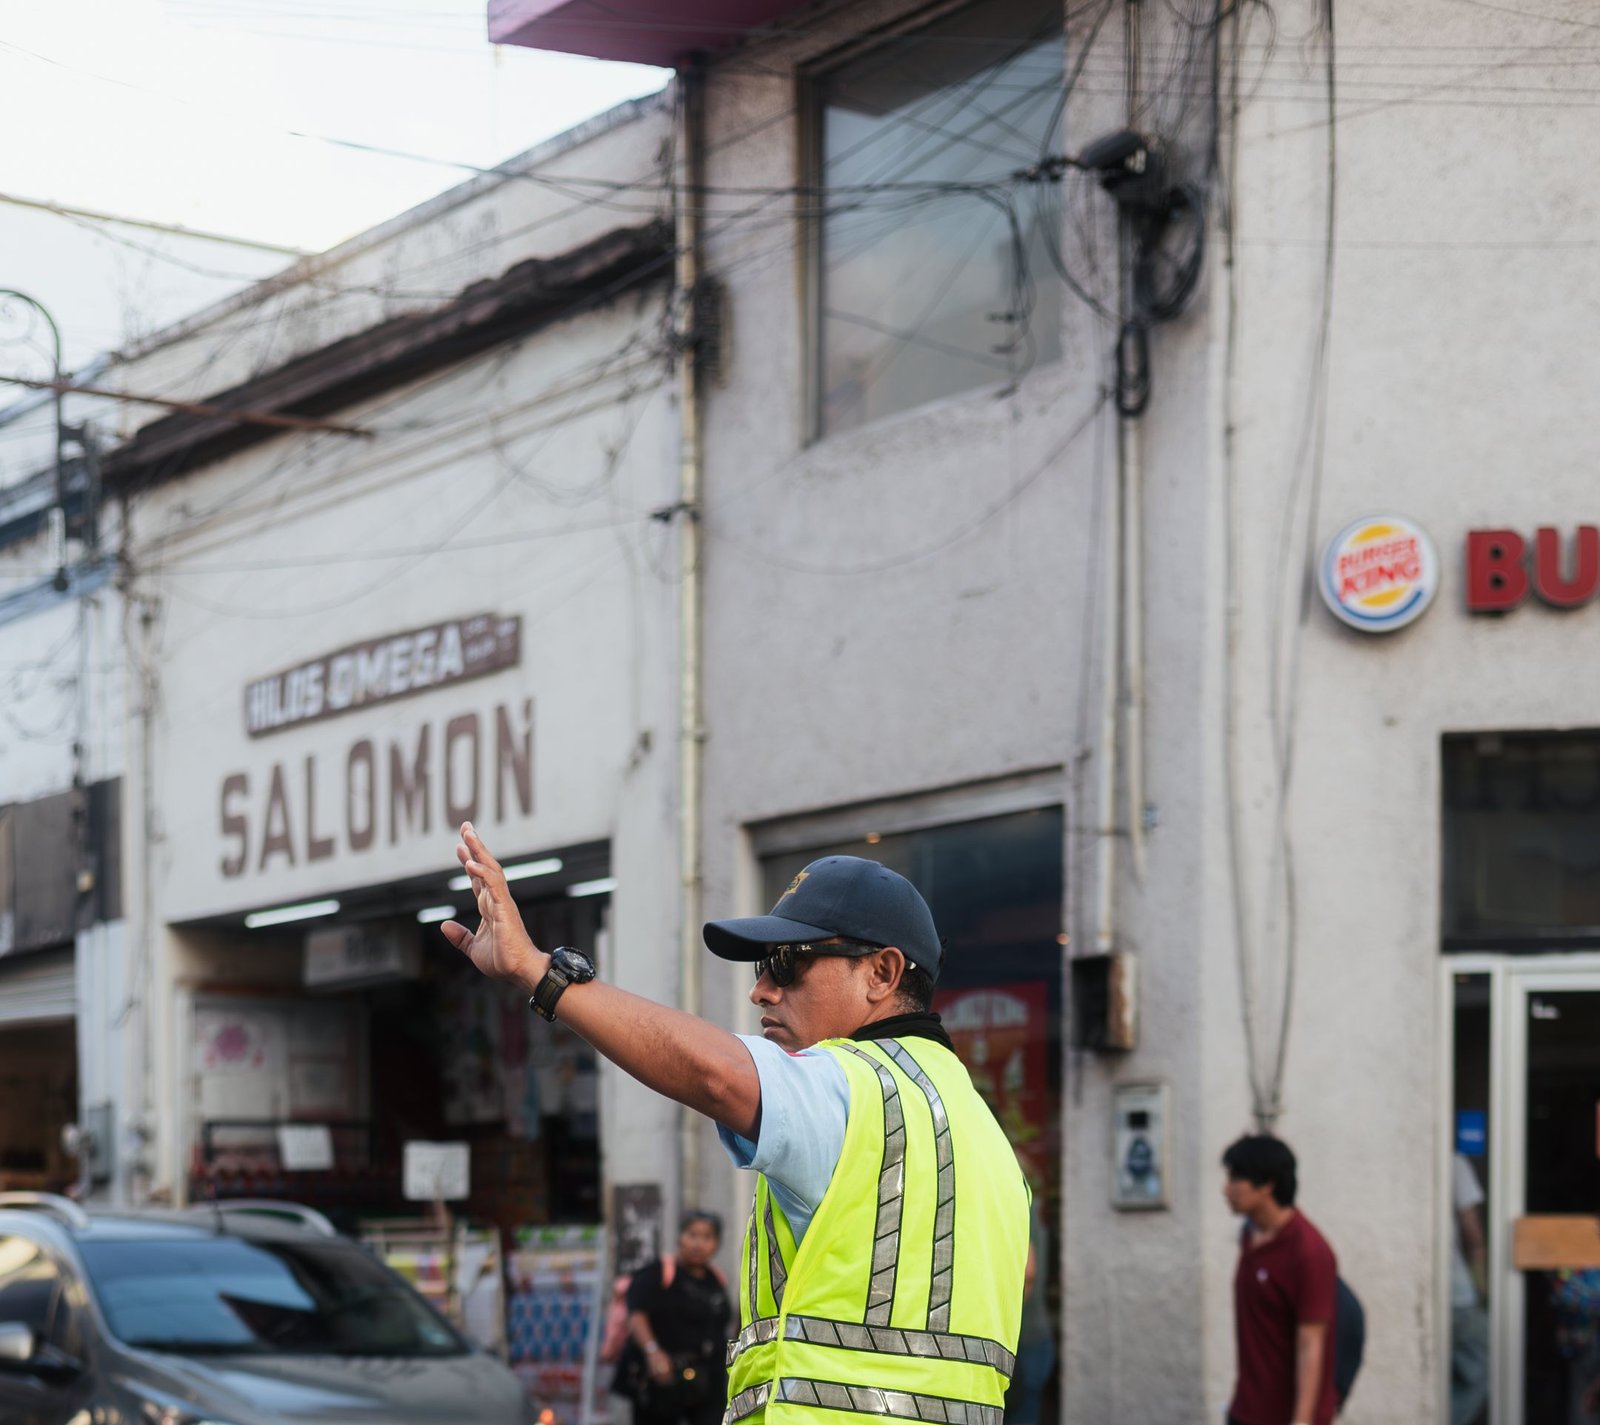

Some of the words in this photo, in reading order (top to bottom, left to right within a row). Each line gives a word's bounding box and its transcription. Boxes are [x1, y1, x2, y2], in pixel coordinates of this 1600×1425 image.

[1339, 558, 1421, 603] KING
[1340, 538, 1418, 572] BURGER
[1467, 526, 1599, 610] BU
[248, 662, 326, 733] HILOS
[326, 623, 465, 711] OMEGA
[219, 698, 535, 880] SALOMON
